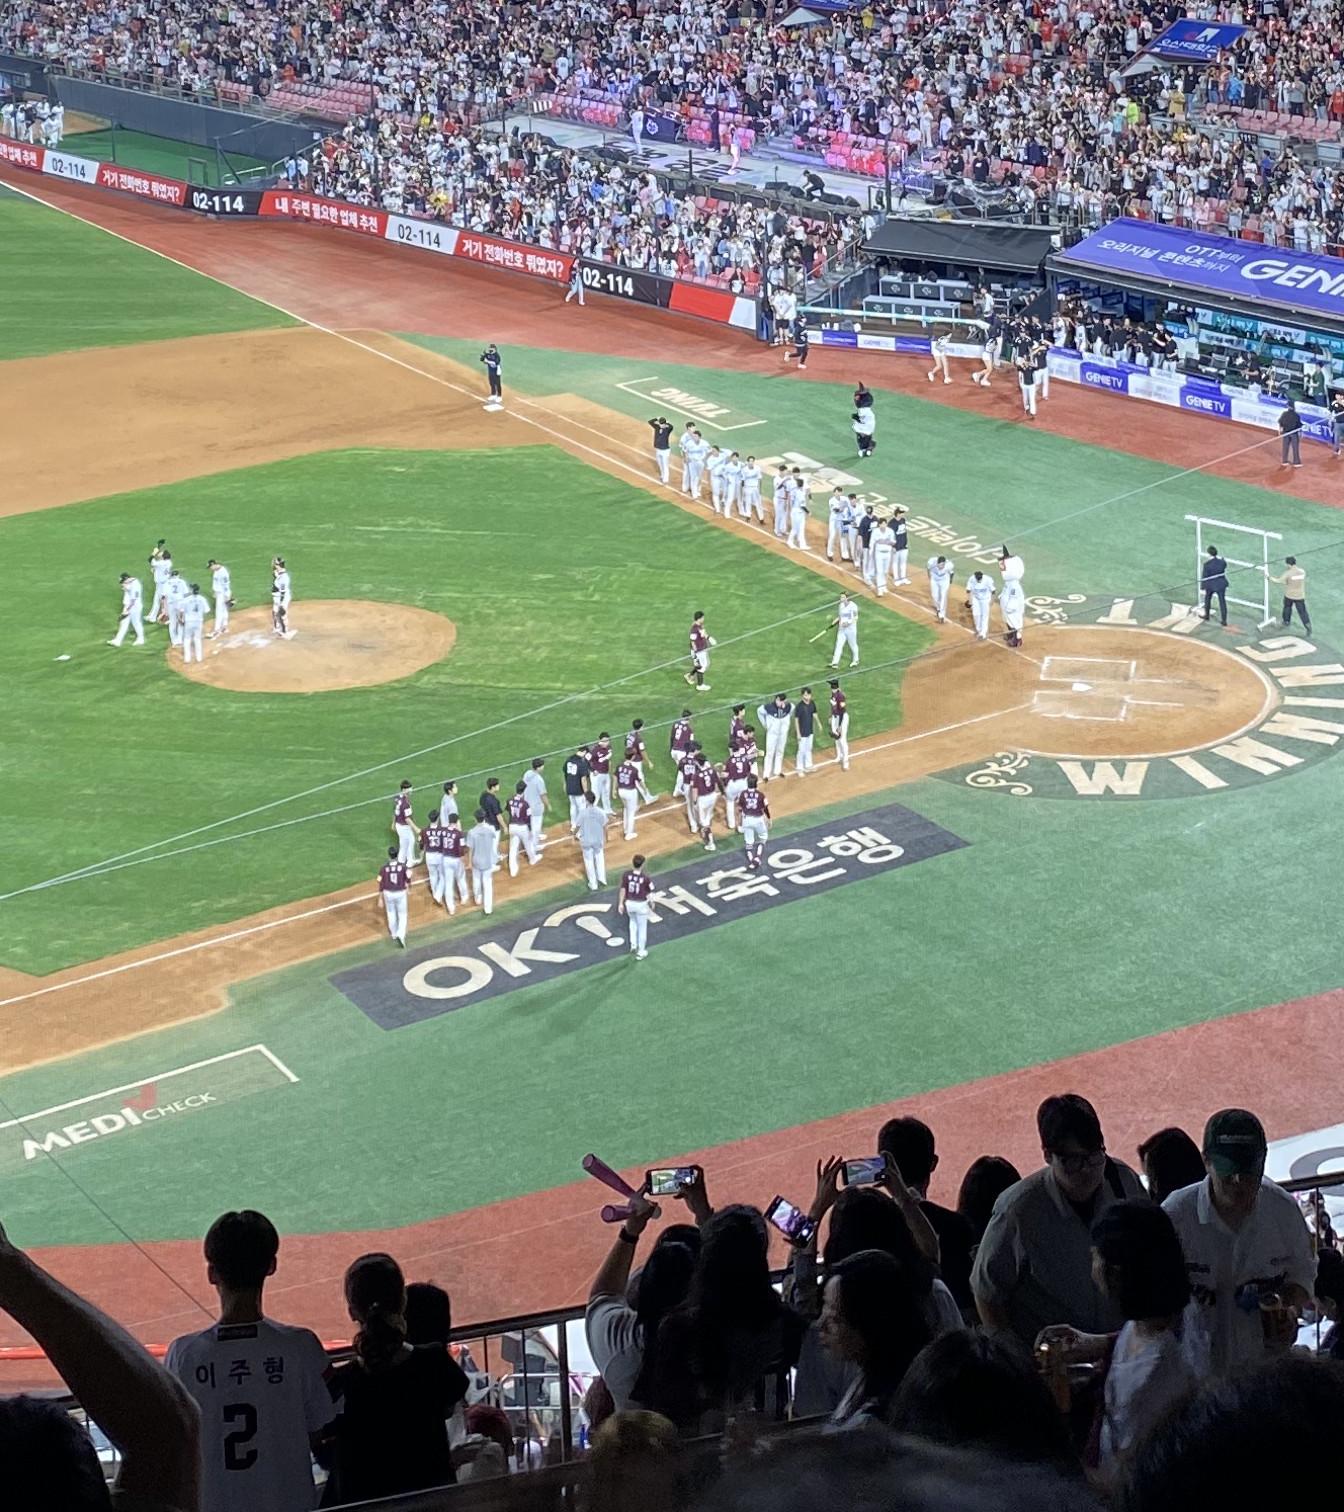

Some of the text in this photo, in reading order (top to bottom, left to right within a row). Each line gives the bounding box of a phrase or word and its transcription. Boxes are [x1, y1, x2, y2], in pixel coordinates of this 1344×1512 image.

[52, 157, 86, 178] 02-114
[103, 170, 117, 187] 거기
[120, 174, 150, 195] 전화번호
[193, 191, 244, 213] 02-114
[275, 197, 378, 233] 내 주변 필요한 업체 추천
[398, 223, 441, 249] 02-114
[462, 239, 564, 278] 거기 전화번호 뭐였지?
[1097, 239, 1161, 259] 오리지널
[1184, 243, 1246, 265] OTT부터
[582, 266, 634, 297] 02-114
[1085, 370, 1124, 389] GENIE TV
[1185, 394, 1226, 413] GENIE TV
[196, 1356, 285, 1388] 이주형
[223, 1402, 259, 1471] 2
